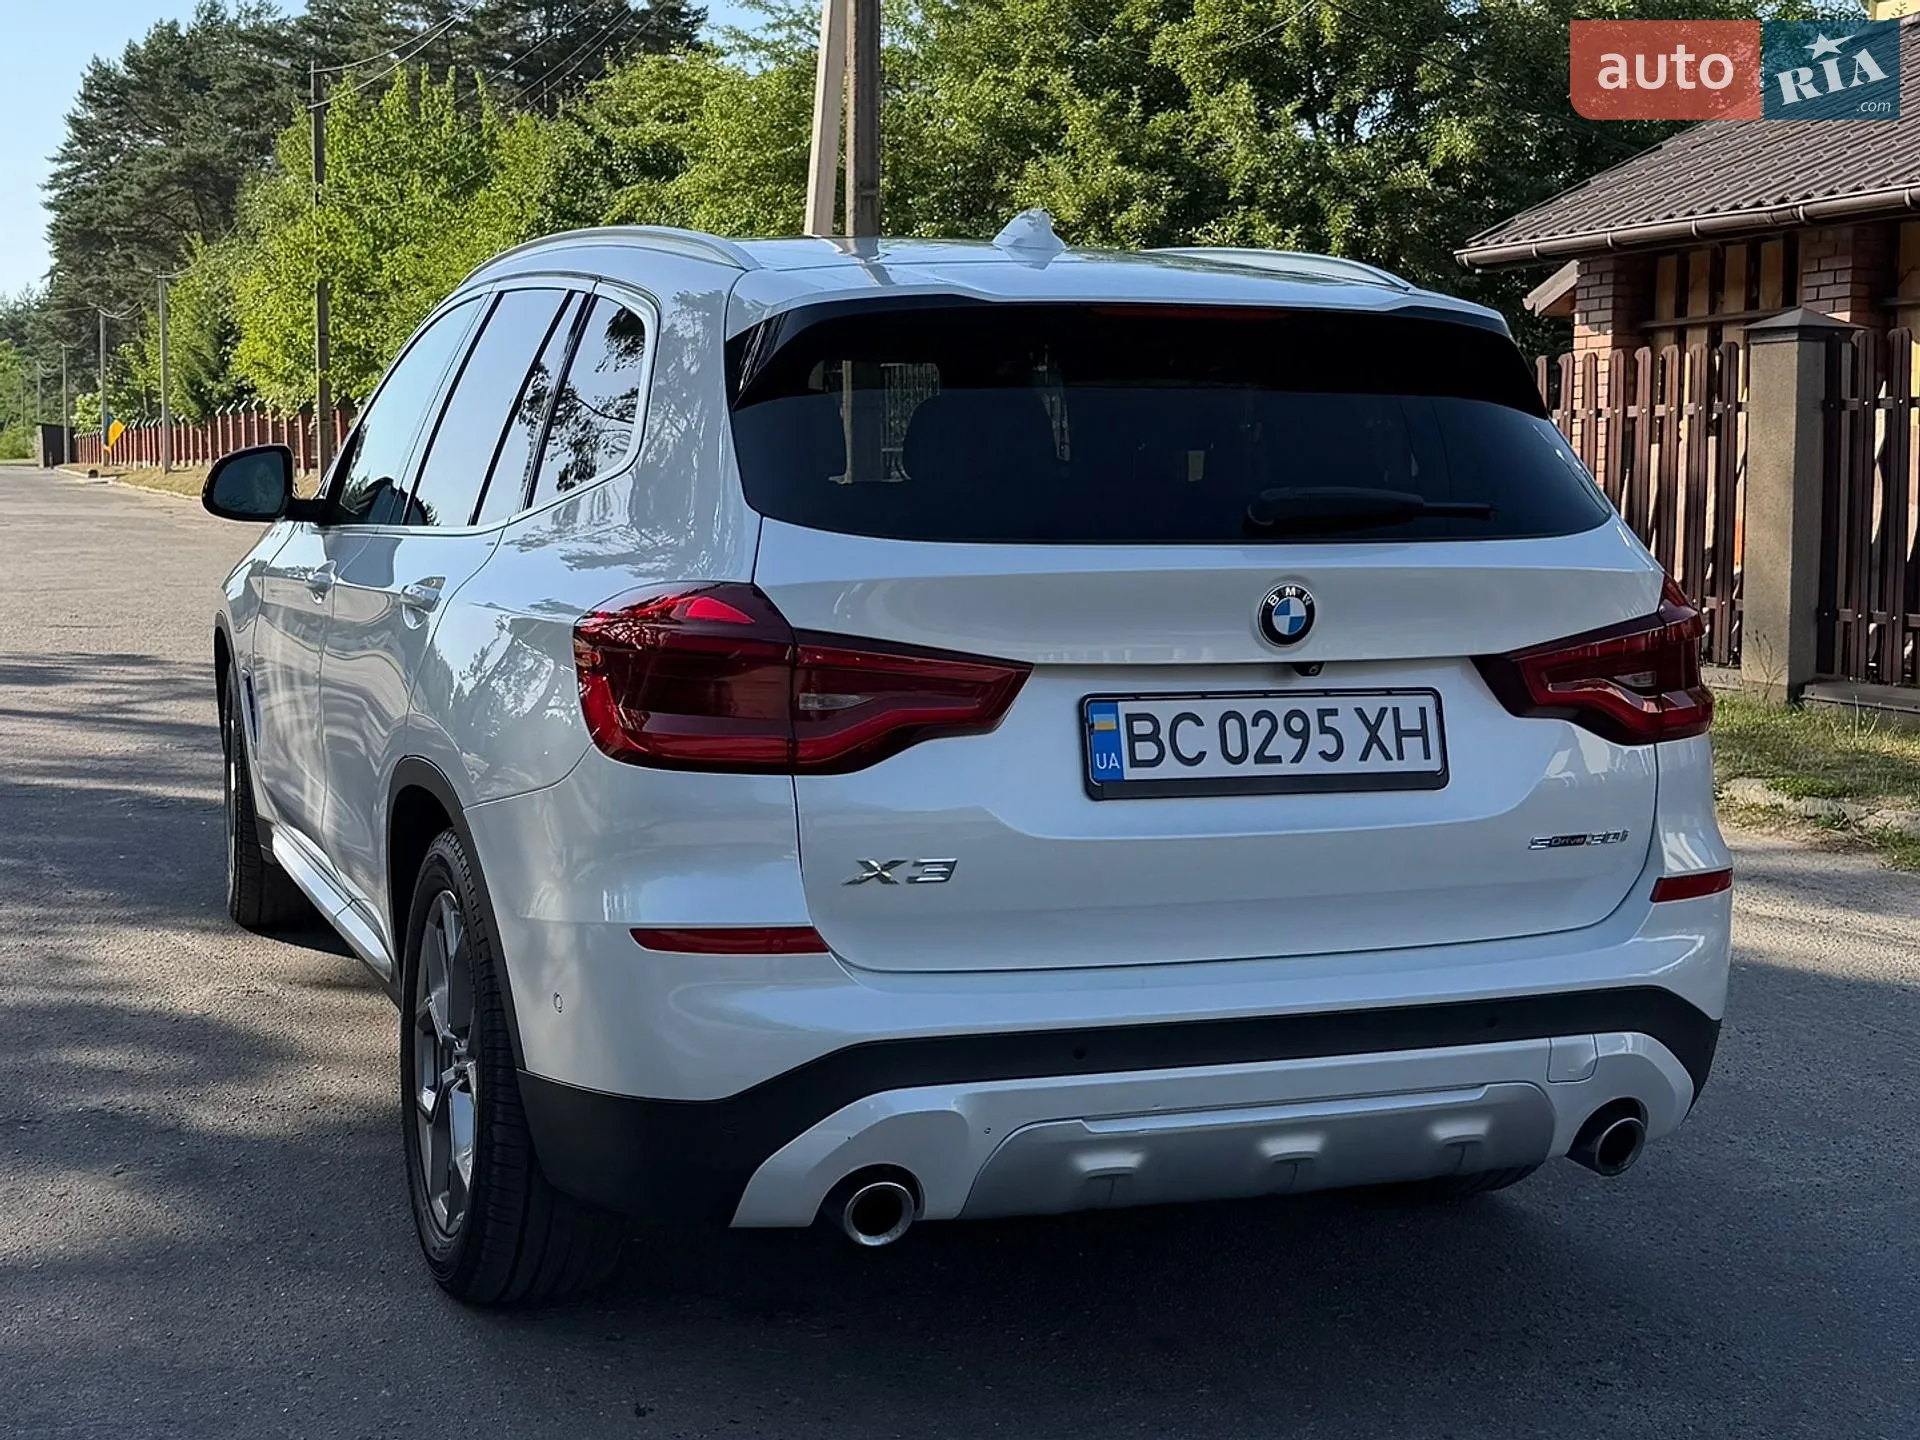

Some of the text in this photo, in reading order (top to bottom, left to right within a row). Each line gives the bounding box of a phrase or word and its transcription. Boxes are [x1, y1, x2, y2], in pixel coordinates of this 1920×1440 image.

[1268, 586, 1312, 606] BMW
[1125, 706, 1432, 769] BC 0295 XH
[1095, 752, 1121, 770] UA
[841, 858, 958, 886] X3
